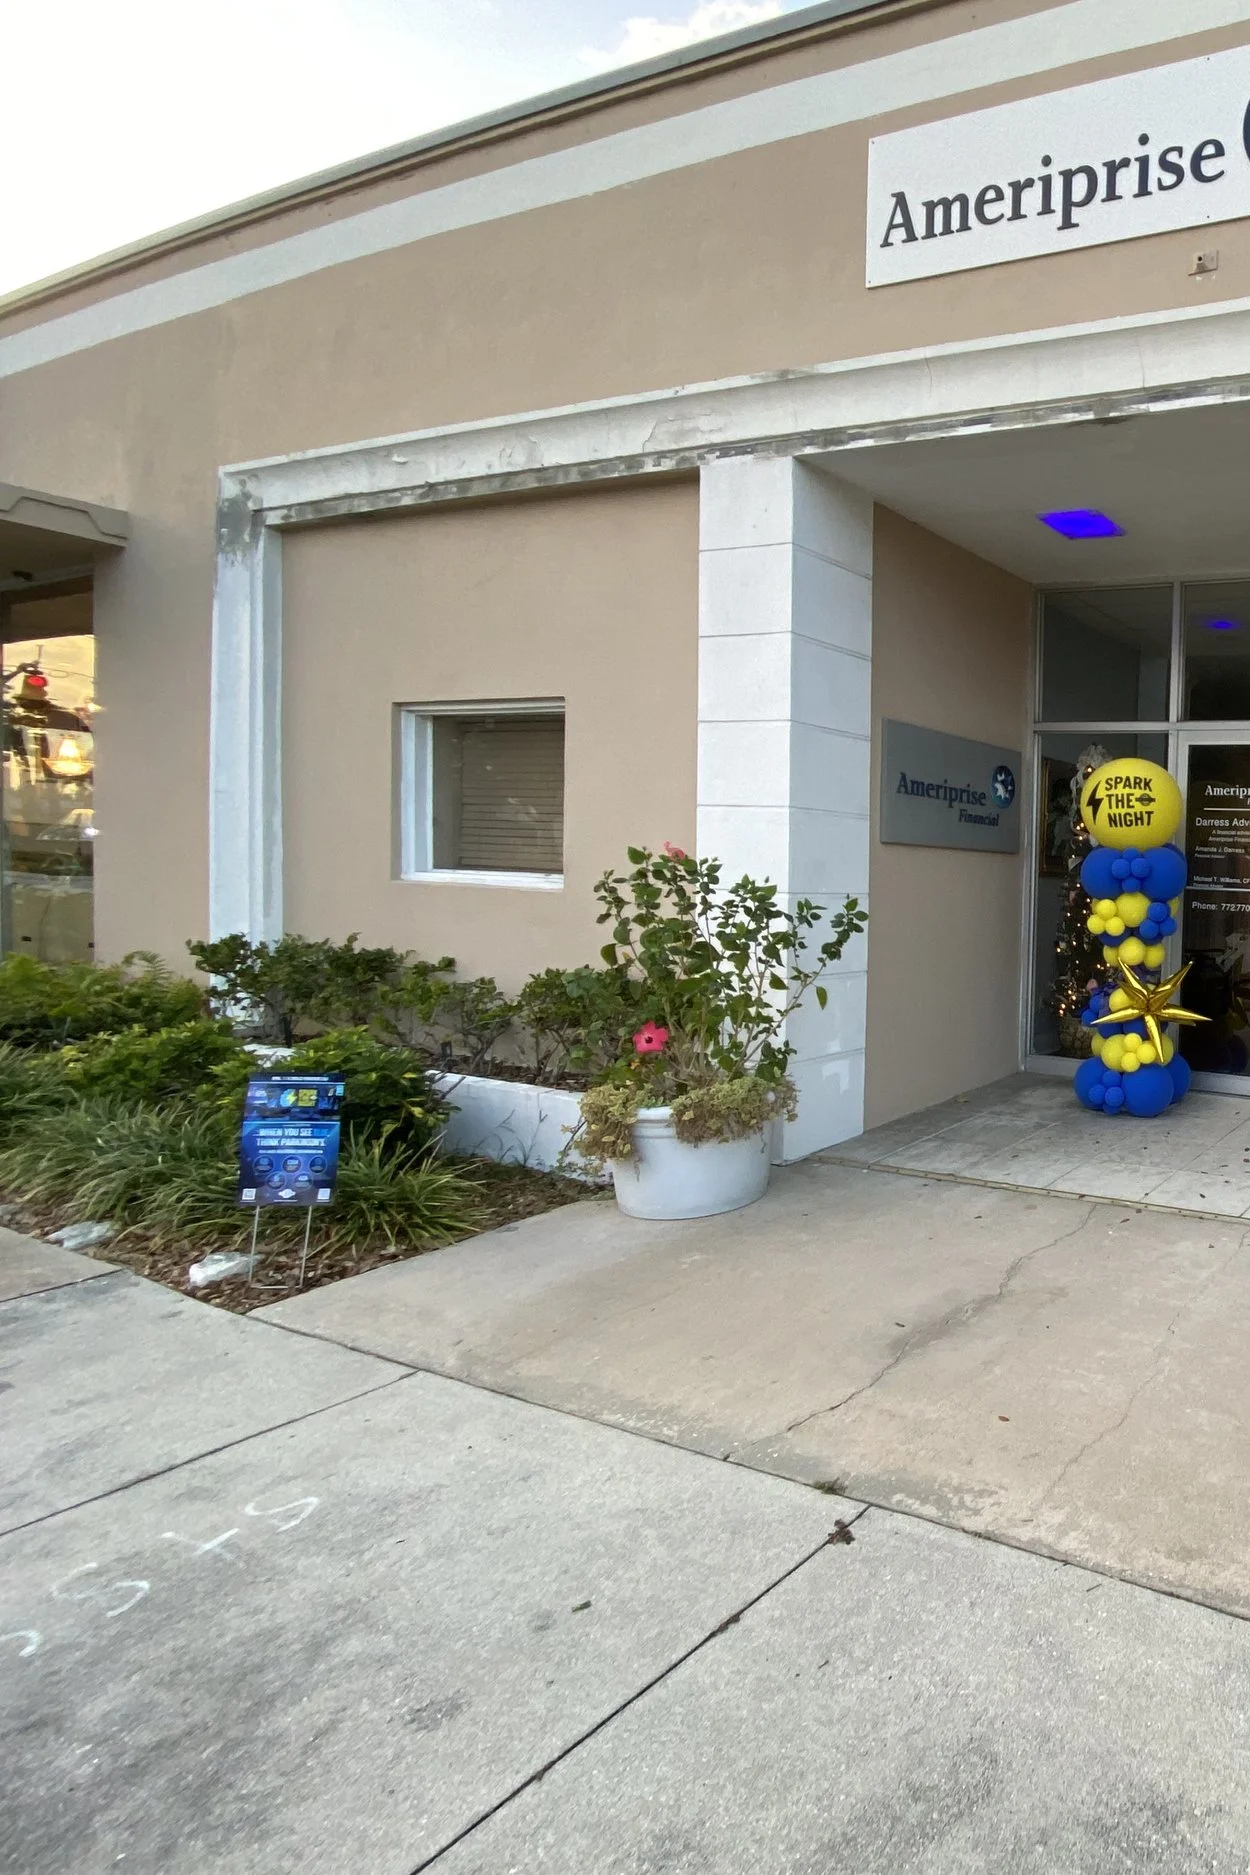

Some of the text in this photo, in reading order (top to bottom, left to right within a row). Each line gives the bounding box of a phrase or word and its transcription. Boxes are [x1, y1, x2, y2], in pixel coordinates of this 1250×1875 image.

[880, 133, 1225, 248] Ameriprise
[897, 771, 986, 808] Ameriprise
[1105, 775, 1152, 792] SPARK
[1105, 793, 1135, 810] THE
[958, 808, 1000, 827] Financial
[1107, 811, 1154, 828] NIGHT
[1195, 817, 1229, 827] Darress
[1192, 901, 1218, 911] Phone:
